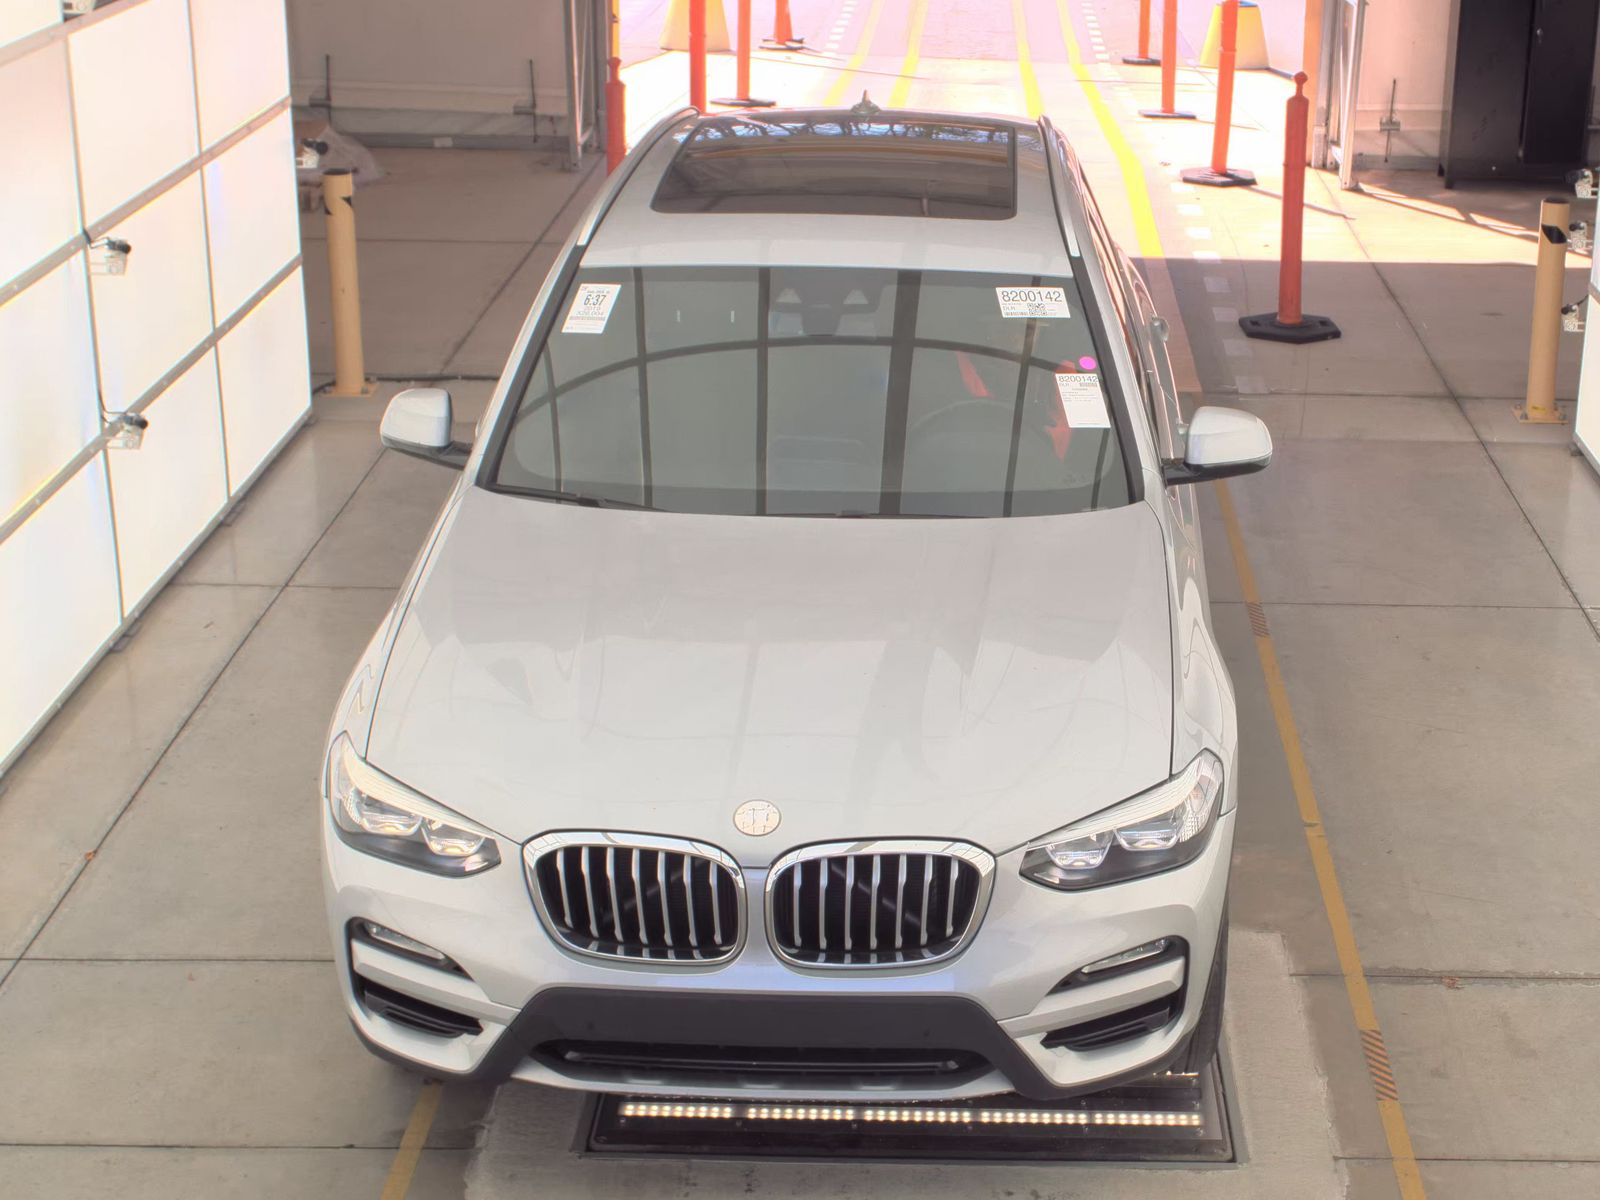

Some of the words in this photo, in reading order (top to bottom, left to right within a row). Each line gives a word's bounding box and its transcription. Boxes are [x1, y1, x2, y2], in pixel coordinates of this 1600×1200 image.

[583, 294, 607, 306] 6:37
[1001, 290, 1063, 303] 8200142
[1058, 375, 1099, 383] 8200142
